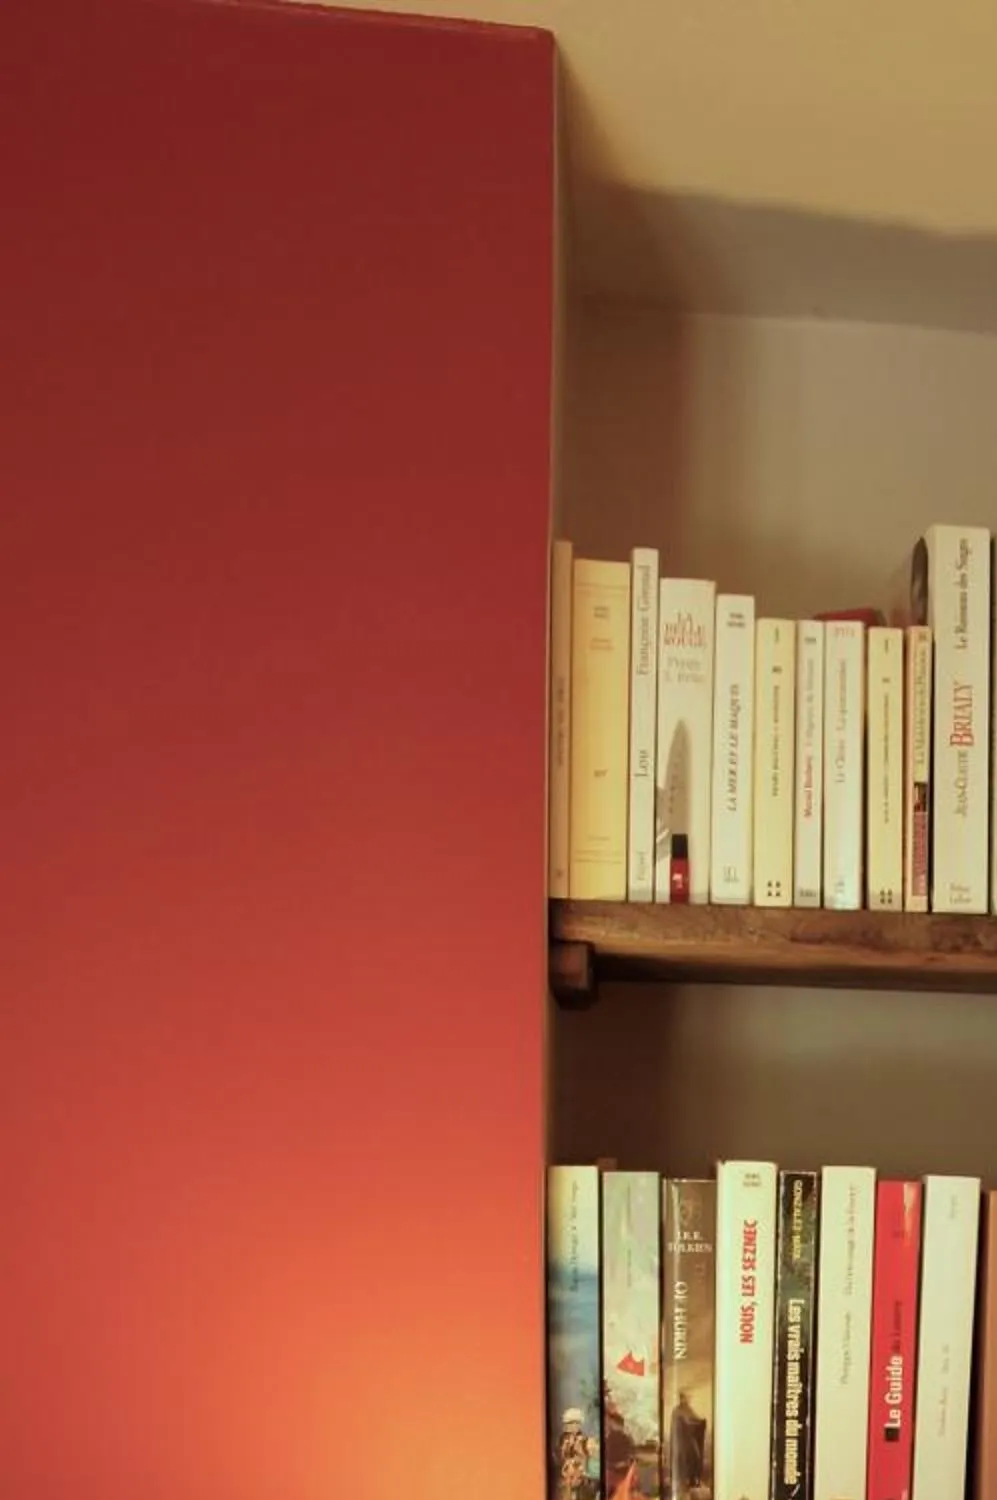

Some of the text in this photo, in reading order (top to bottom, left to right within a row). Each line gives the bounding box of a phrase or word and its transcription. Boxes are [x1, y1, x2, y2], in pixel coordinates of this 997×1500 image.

[949, 679, 974, 748] BRIALY
[634, 749, 649, 777] Lou
[739, 1218, 758, 1344] NOUS, LES SEZNEC
[783, 1298, 805, 1486] Les vrais maîtres du monde
[884, 1355, 903, 1405] Guide
[884, 1408, 901, 1428] Le
